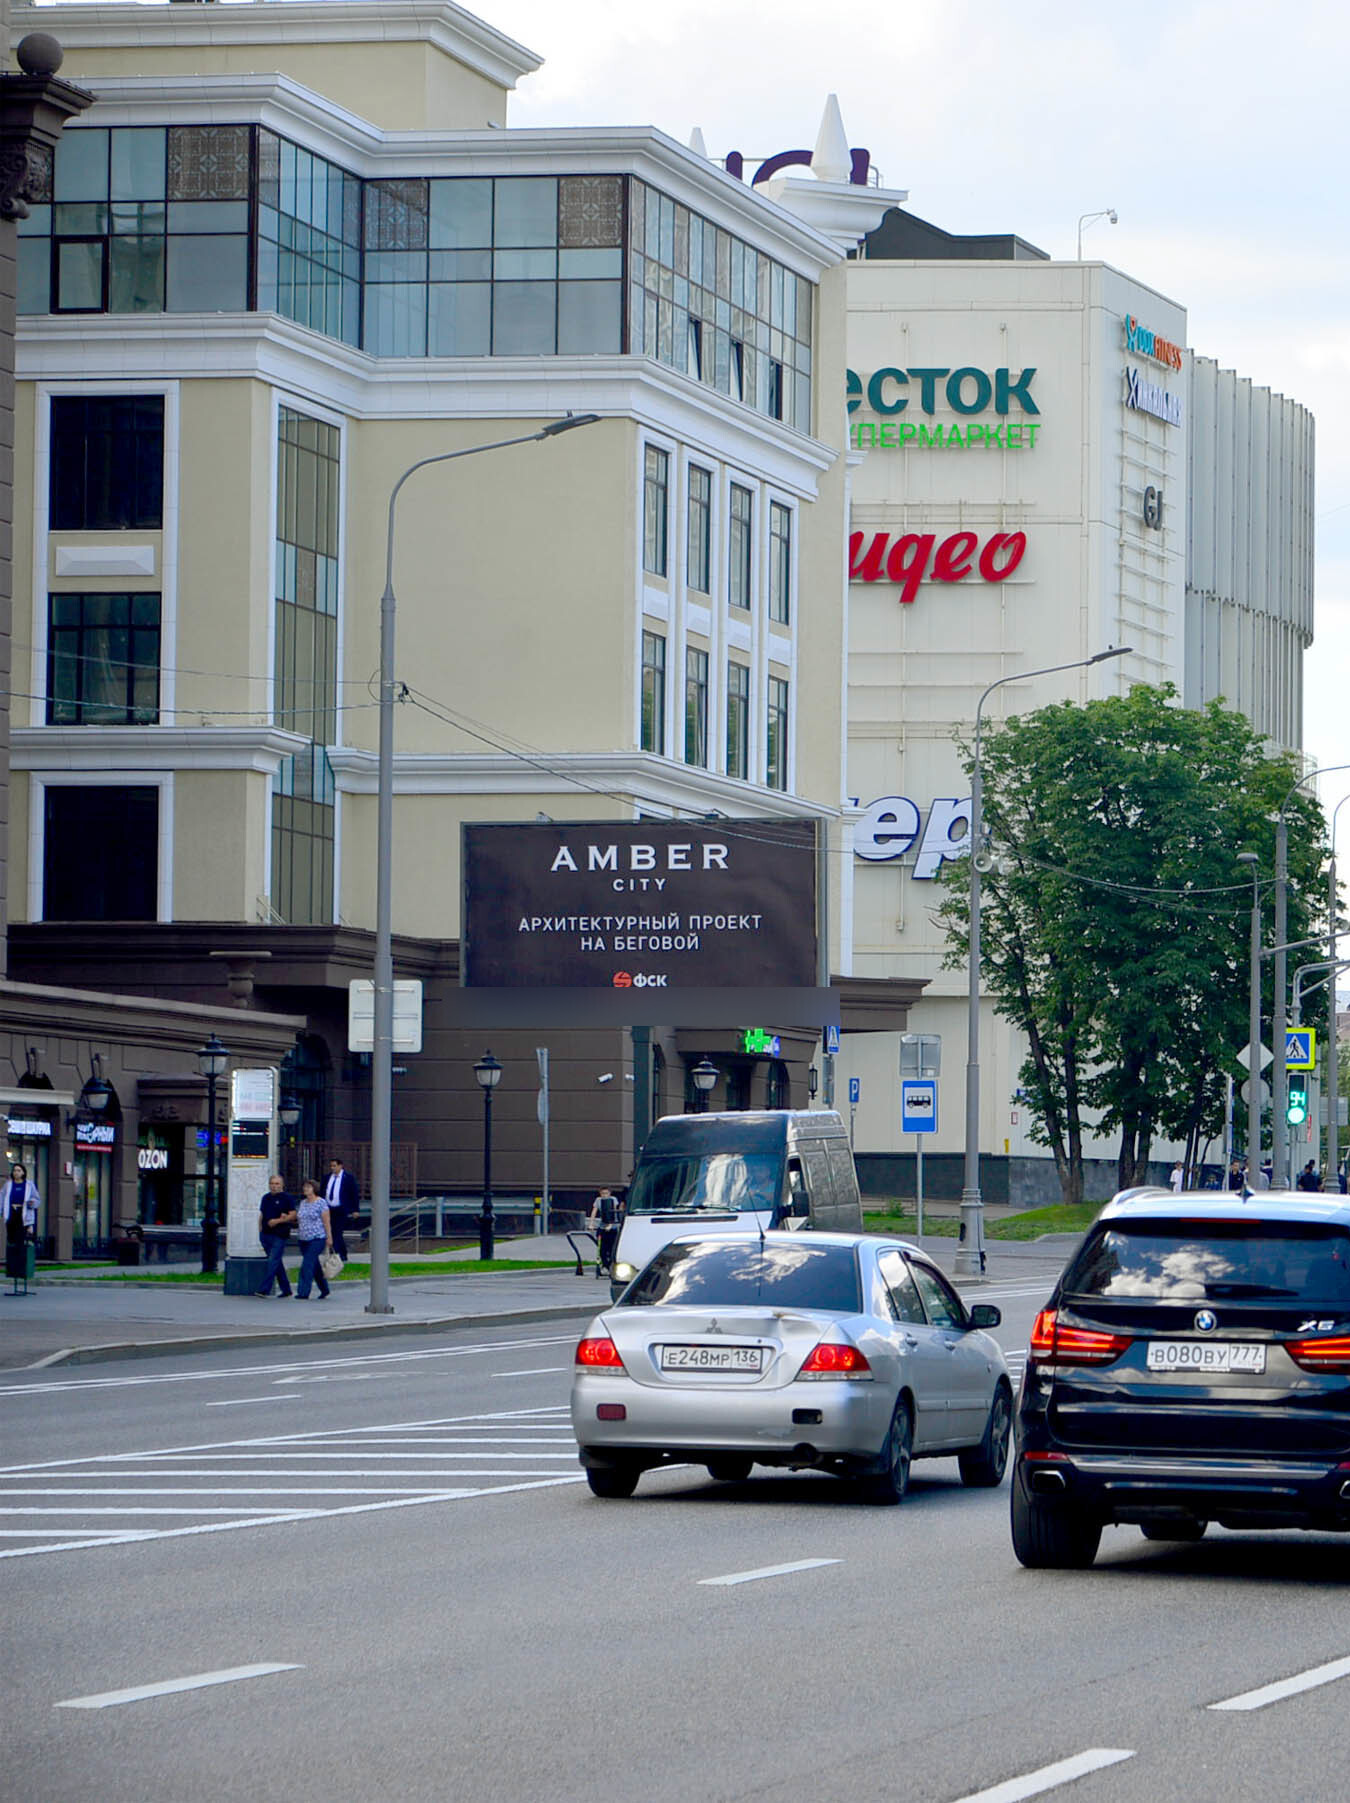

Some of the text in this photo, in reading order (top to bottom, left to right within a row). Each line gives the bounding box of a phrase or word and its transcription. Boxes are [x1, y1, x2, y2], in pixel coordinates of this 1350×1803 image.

[550, 843, 730, 872] AMBER
[612, 879, 667, 892] CITY
[519, 911, 763, 932] АРХИТЕКТУРНЫЙ ПРОЕКТ
[580, 932, 700, 951] НА БЕГОВОЙ
[633, 972, 668, 988] ФСК
[137, 1148, 168, 1169] OZON
[666, 1349, 757, 1367] Е248МР 136
[1154, 1345, 1260, 1365] В080ВУ 777
